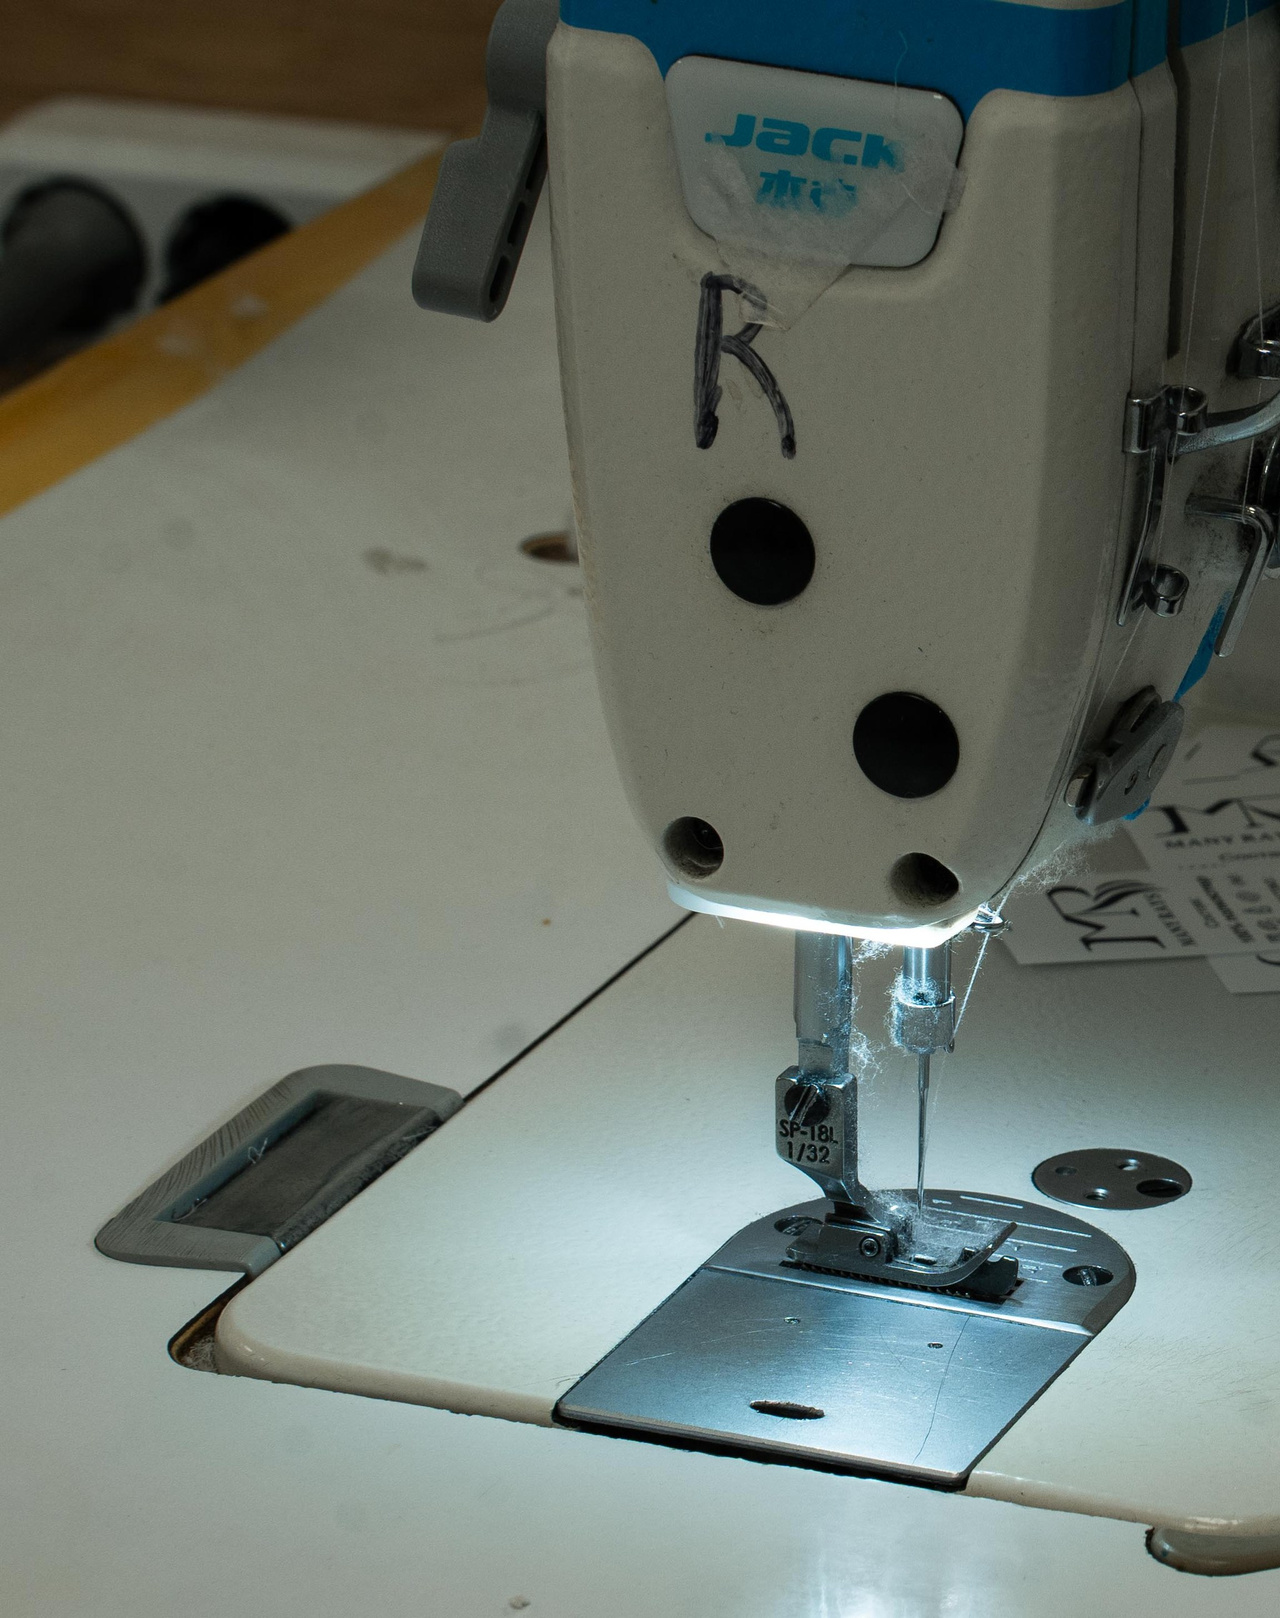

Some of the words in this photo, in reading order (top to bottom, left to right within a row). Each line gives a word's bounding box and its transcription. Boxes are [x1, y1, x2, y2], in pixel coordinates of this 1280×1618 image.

[694, 272, 797, 460] R
[779, 1120, 838, 1144] SP-18L
[787, 1141, 830, 1164] 1/32
